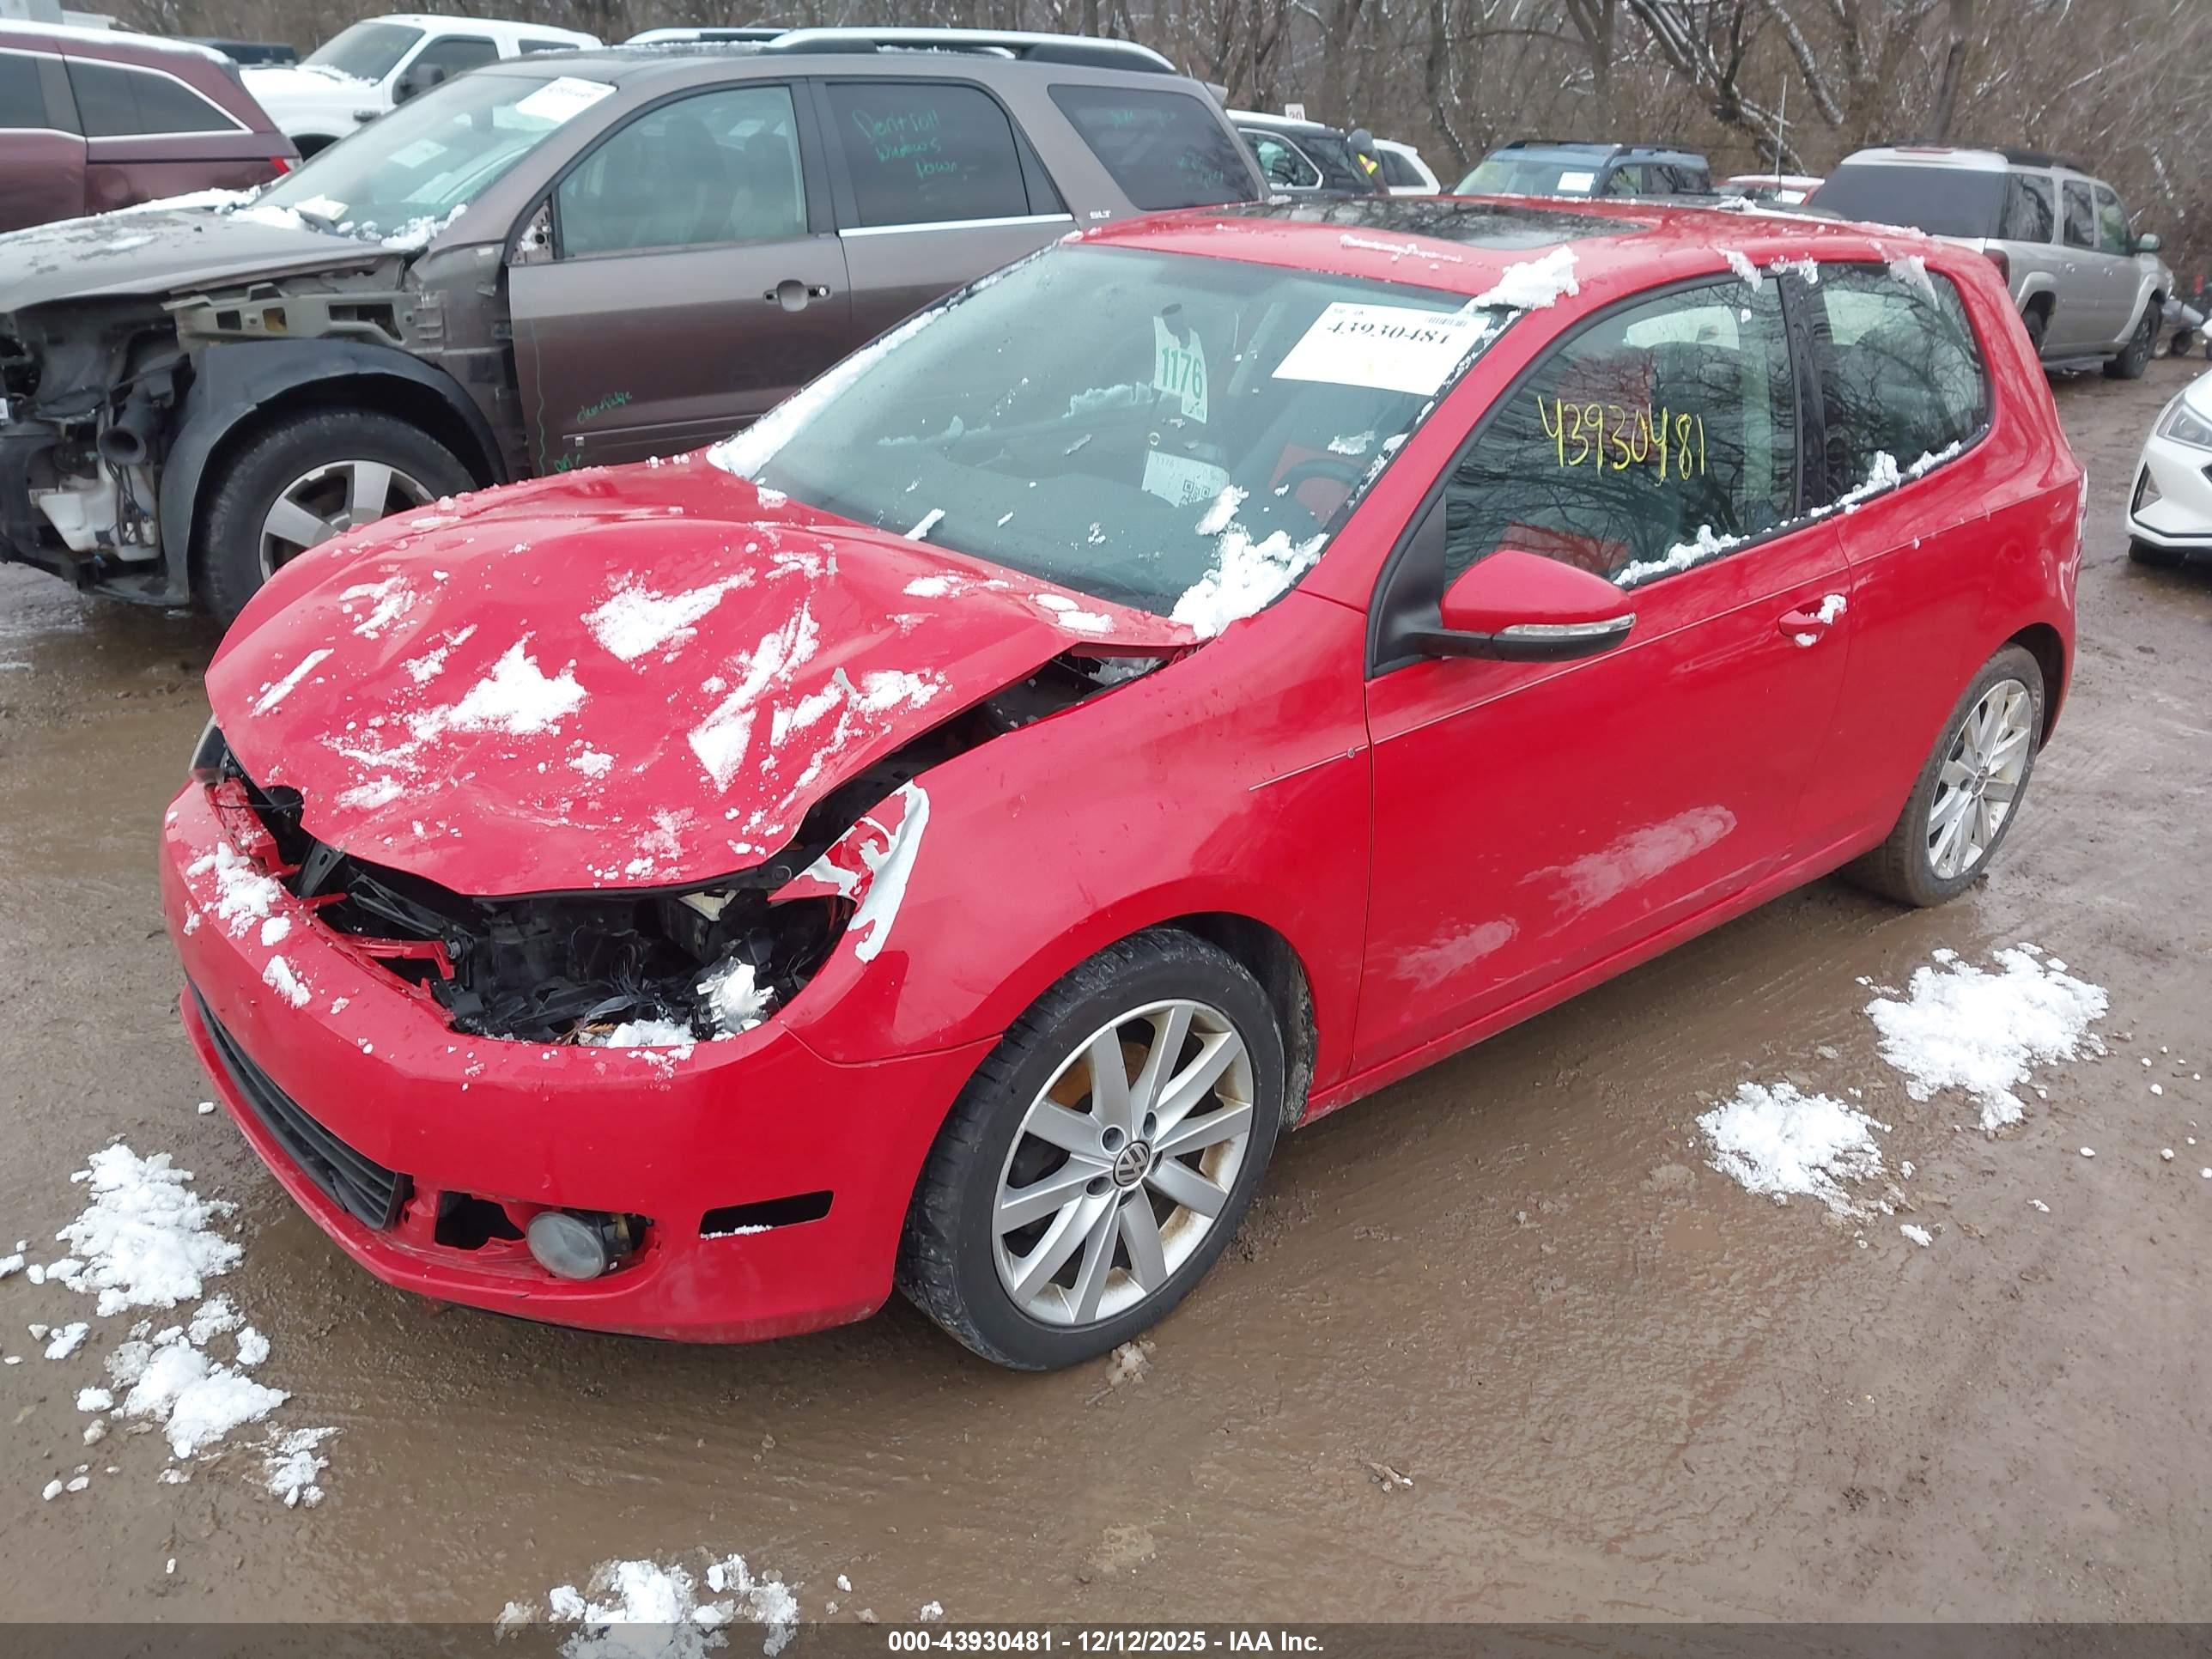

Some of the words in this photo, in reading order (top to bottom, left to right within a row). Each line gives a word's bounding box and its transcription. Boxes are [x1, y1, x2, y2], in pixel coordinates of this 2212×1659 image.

[1327, 319, 1450, 344] 43930481
[1162, 346, 1203, 399] 1176
[1538, 395, 1705, 487] 43930481
